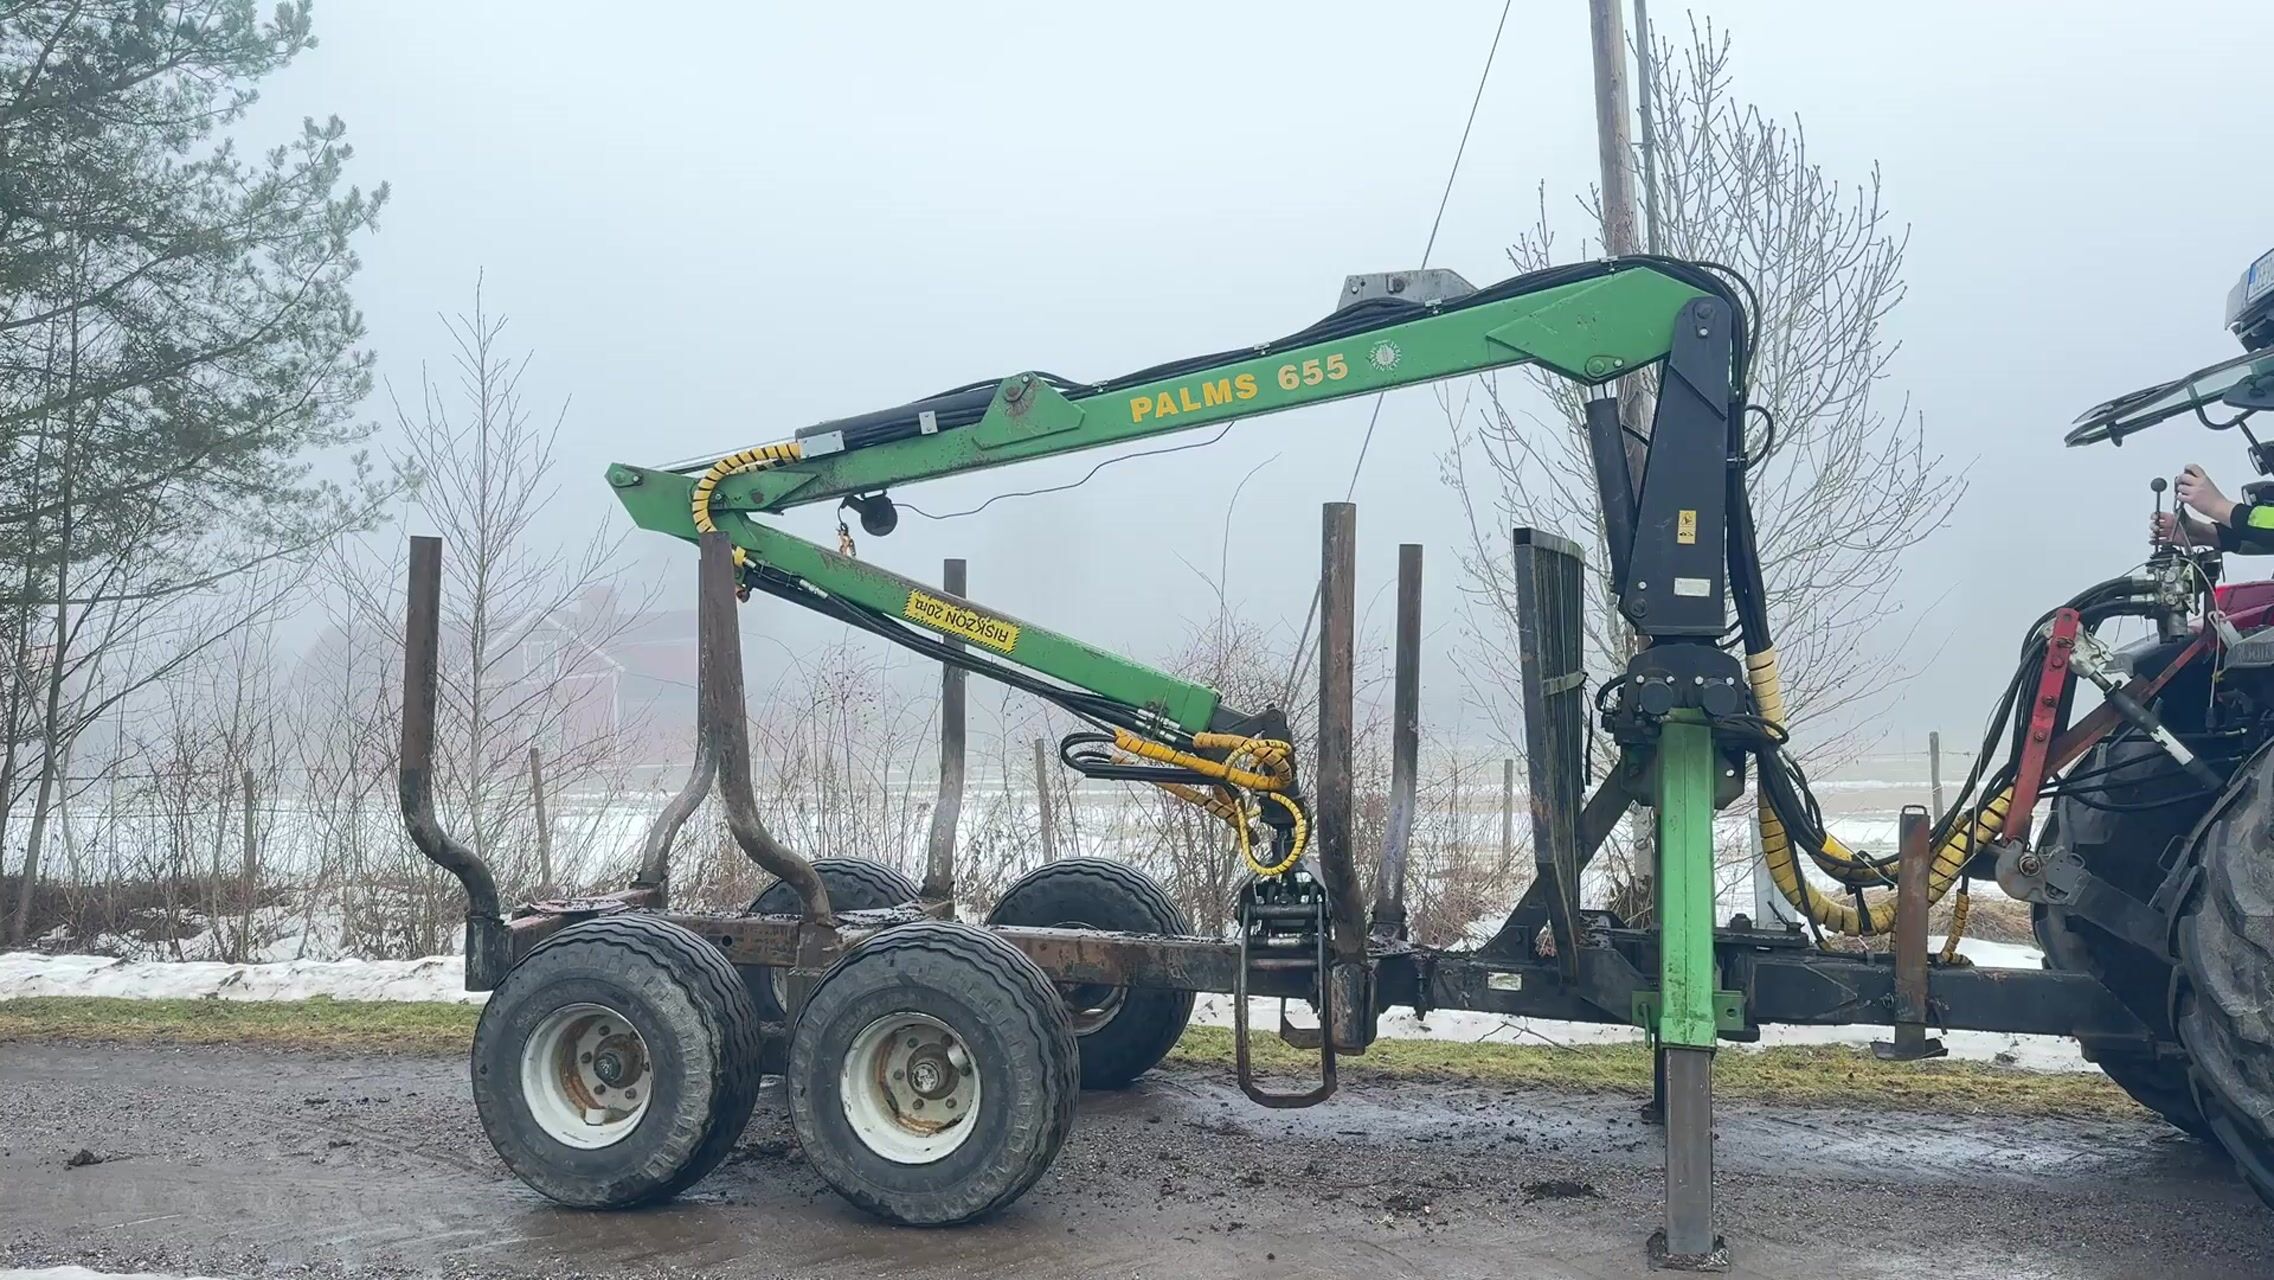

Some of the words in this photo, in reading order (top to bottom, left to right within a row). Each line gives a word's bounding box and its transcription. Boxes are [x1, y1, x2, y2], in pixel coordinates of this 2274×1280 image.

[1129, 373, 1258, 422] PALMS
[1278, 353, 1349, 391] 655
[945, 610, 1009, 643] RISKZON
